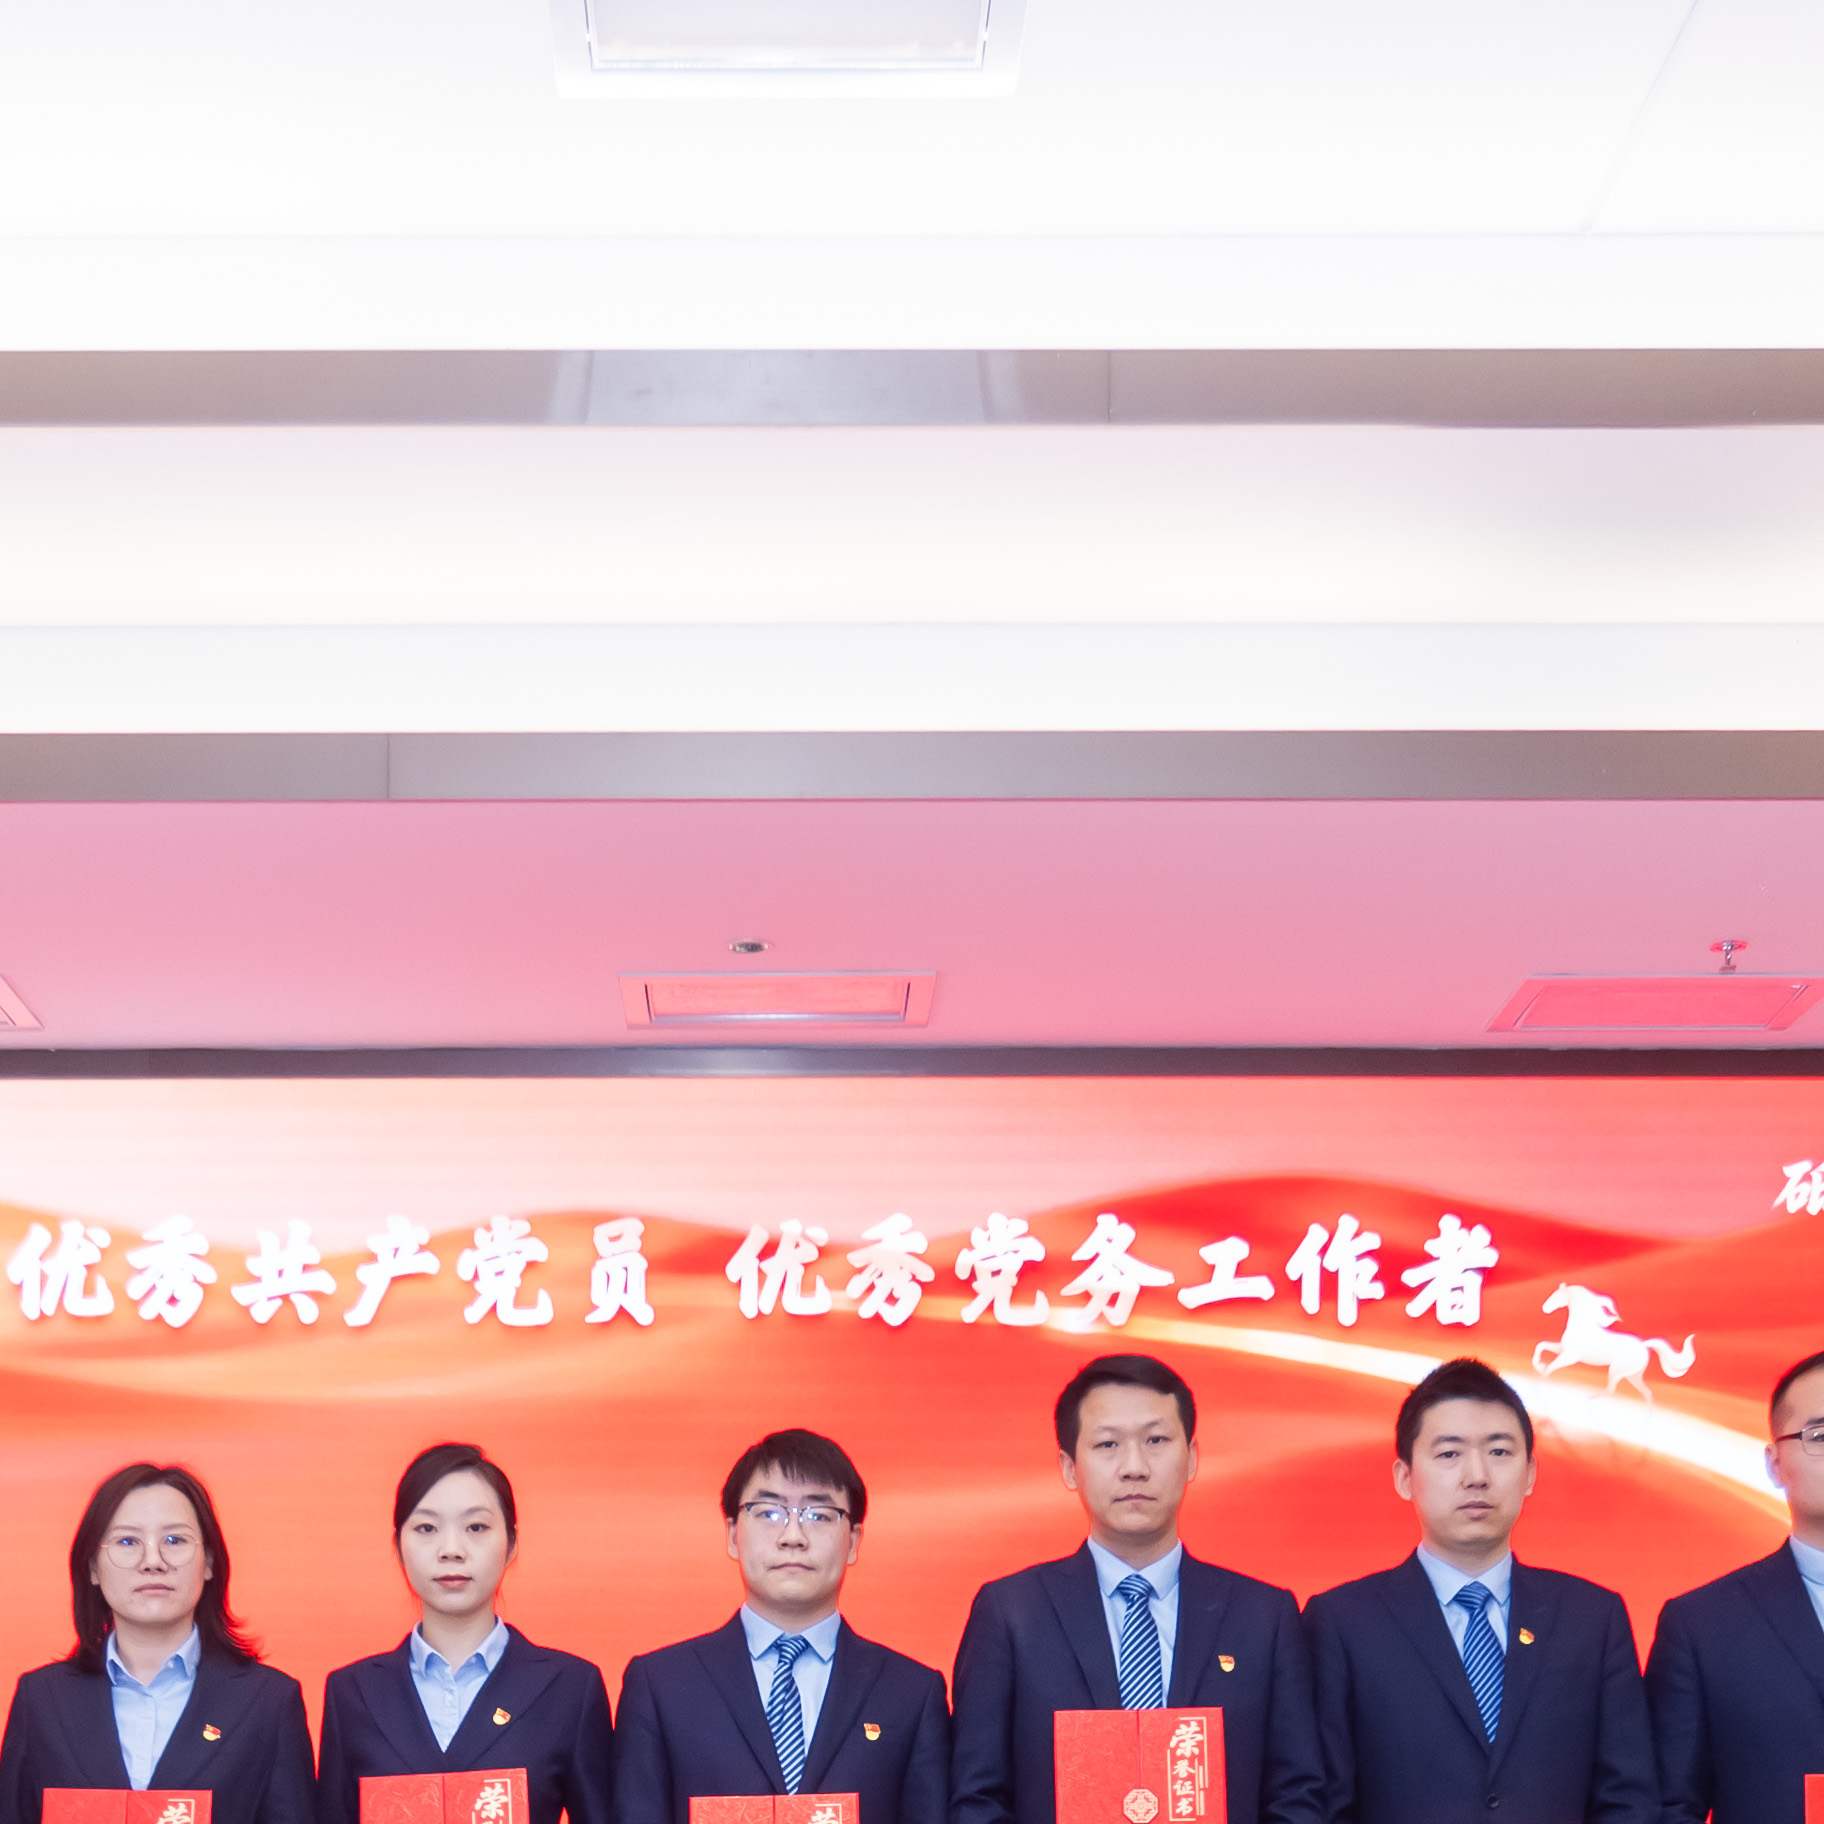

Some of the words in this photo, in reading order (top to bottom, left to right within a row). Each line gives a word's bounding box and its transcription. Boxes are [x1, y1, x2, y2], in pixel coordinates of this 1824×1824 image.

[6, 1214, 655, 1328] 优秀共产党员
[725, 1212, 1499, 1327] 优秀党务工作者
[1170, 1721, 1204, 1816] 荣誉证书
